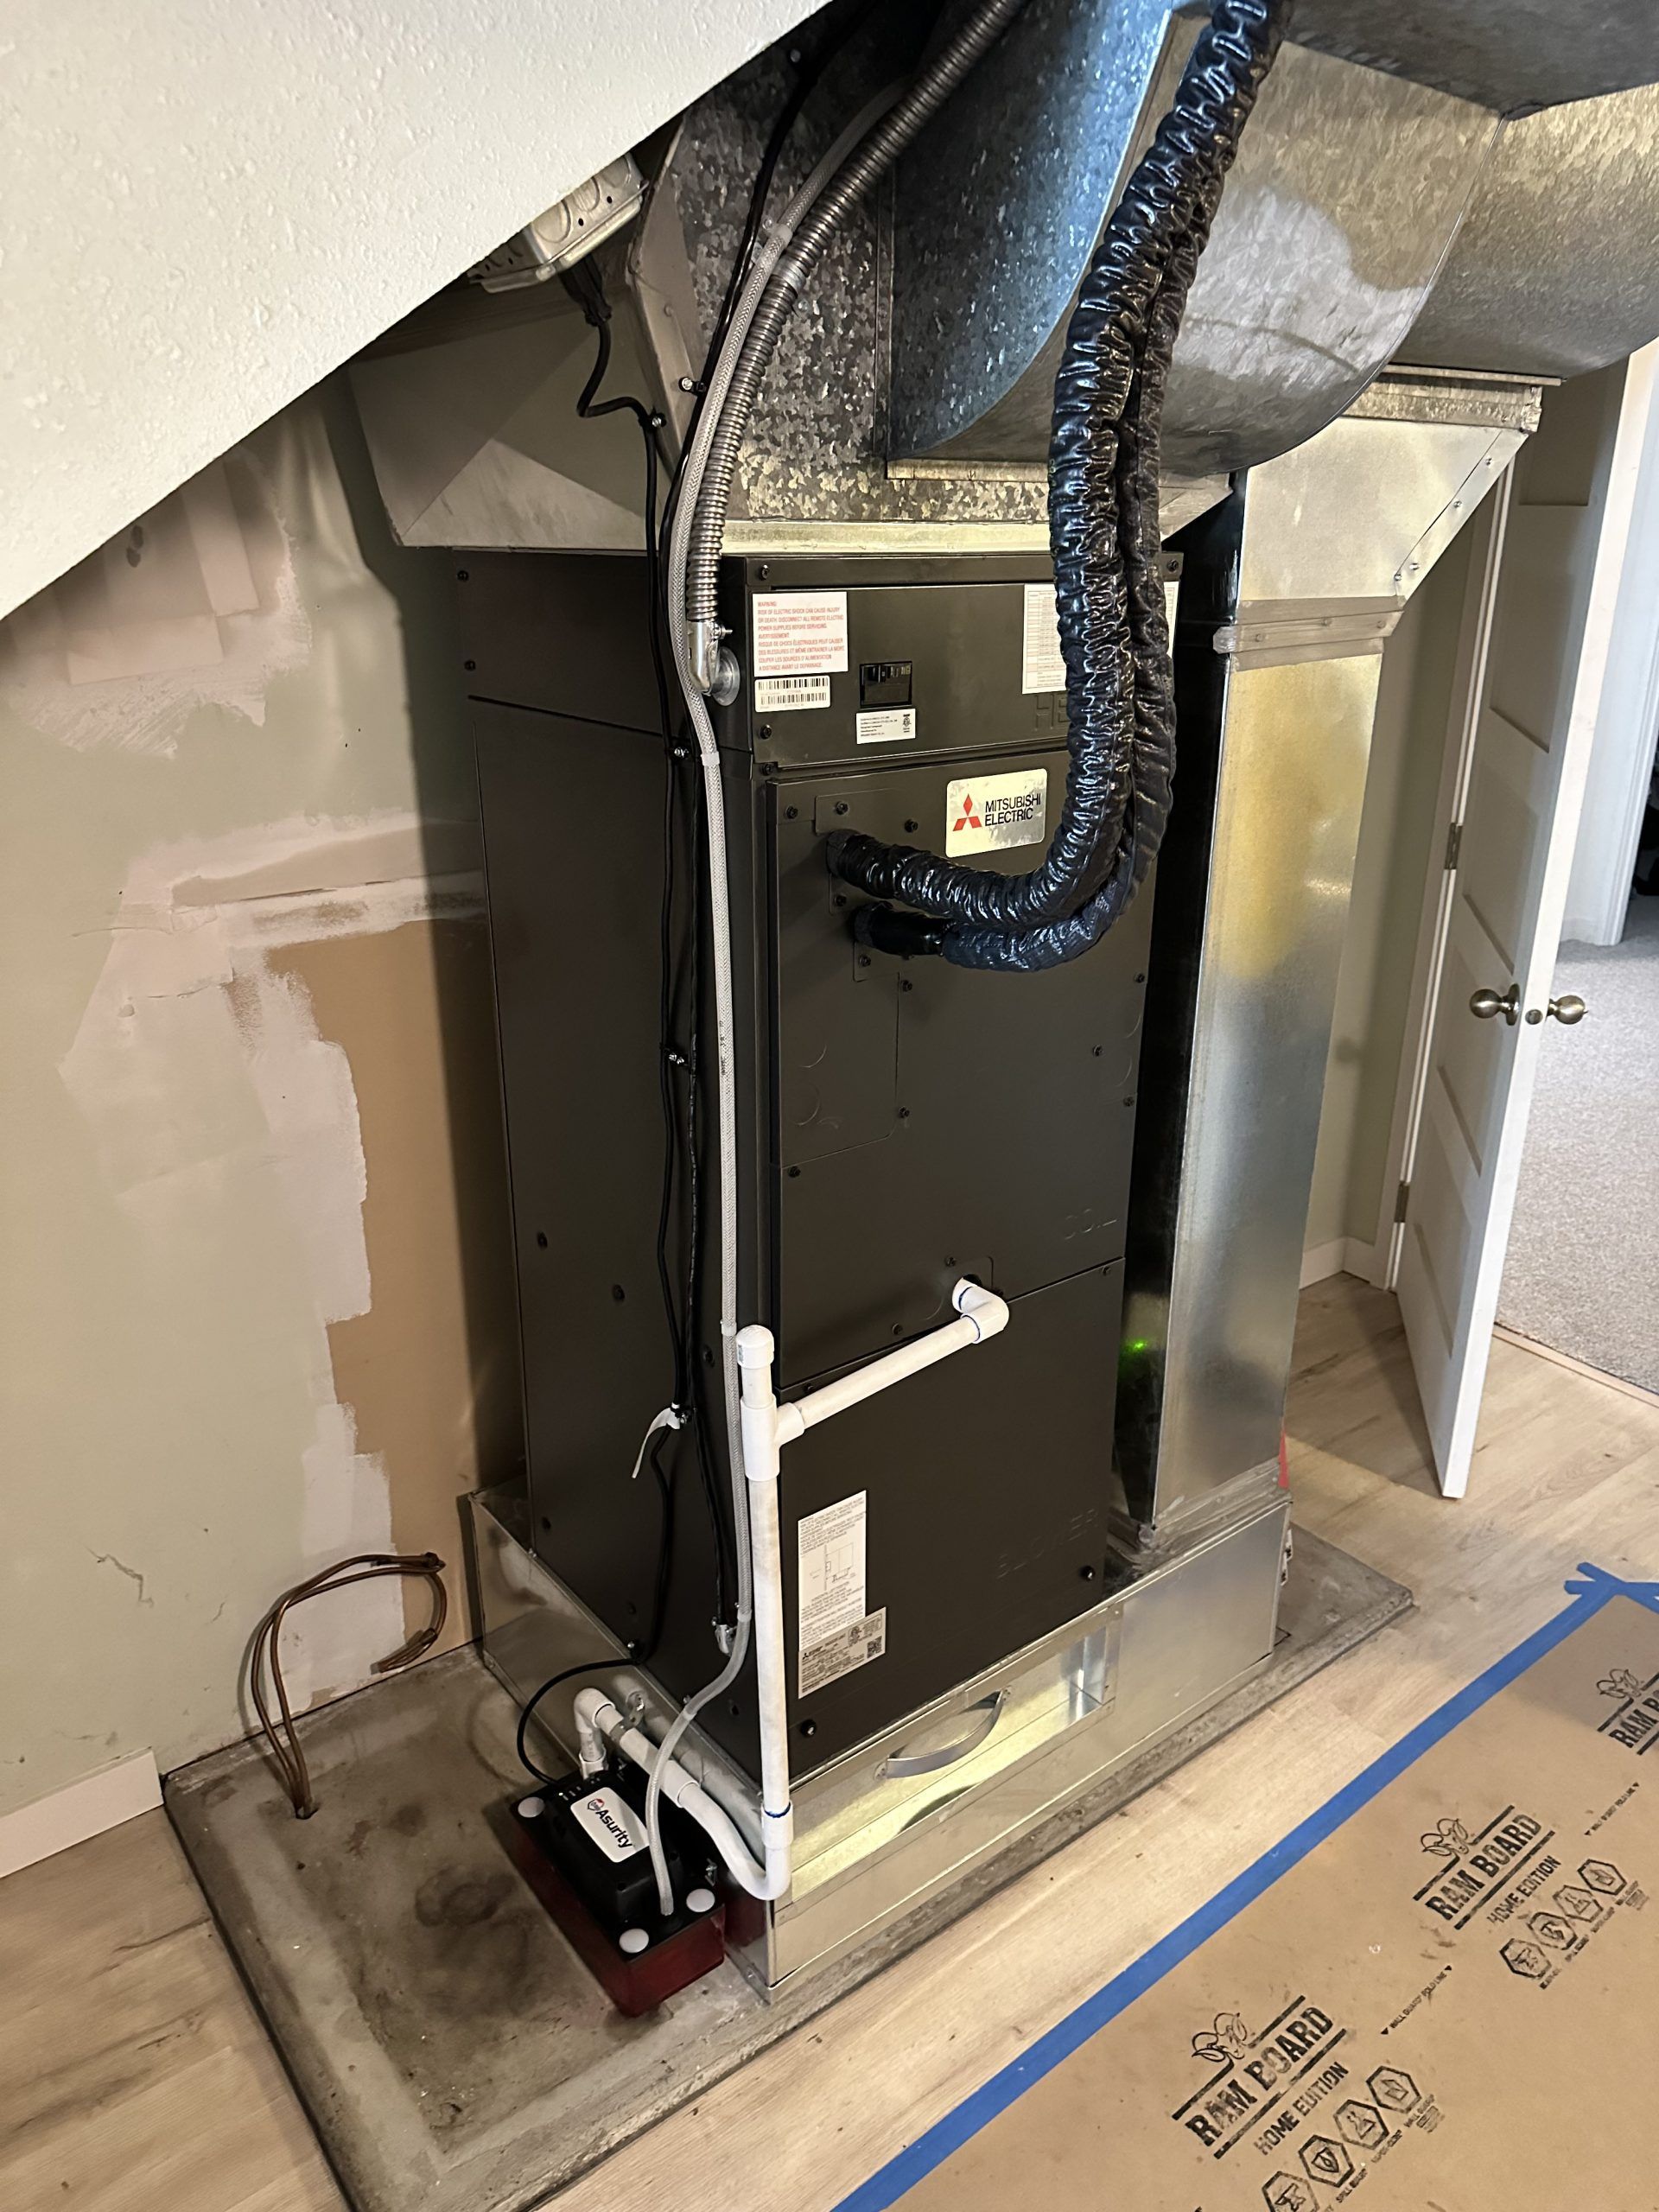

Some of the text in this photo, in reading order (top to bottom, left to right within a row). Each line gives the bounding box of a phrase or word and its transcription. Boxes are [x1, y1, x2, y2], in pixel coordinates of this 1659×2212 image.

[985, 792, 1041, 813] MITSUBISHI
[985, 807, 1033, 827] ELECTRIC
[1608, 1708, 1659, 1749] RAM
[595, 1809, 632, 1848] Asurity
[1425, 1815, 1541, 1921] RAM BOARD
[1486, 1855, 1561, 1923] HOME EDITION
[1389, 2012, 1406, 2030] WALL
[1421, 1981, 1437, 1998] FOLD
[1185, 2006, 1333, 2147] RAM BOARD
[1253, 2062, 1349, 2156] HOME EDITION
